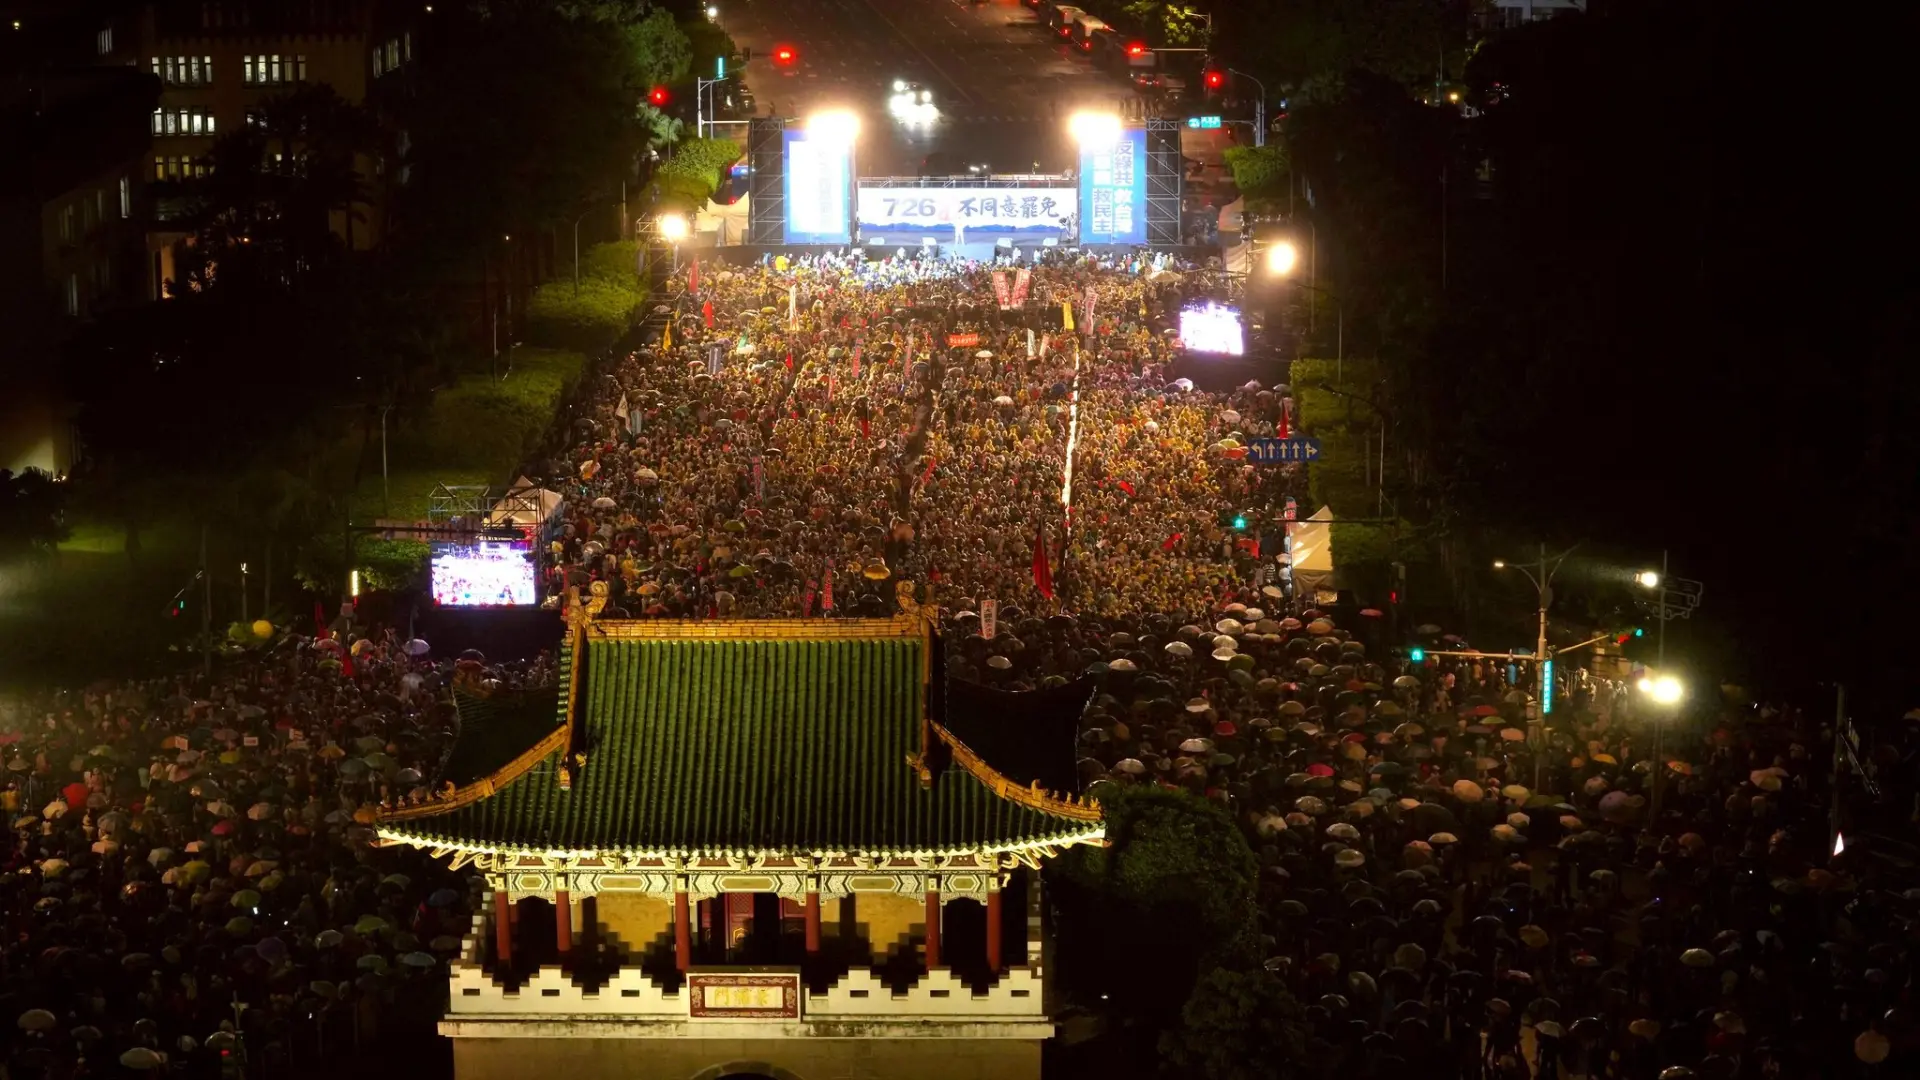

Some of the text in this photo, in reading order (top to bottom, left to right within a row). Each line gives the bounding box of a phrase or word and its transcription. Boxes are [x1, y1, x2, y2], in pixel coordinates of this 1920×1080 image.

[883, 195, 1060, 219] 726 不同意罷免
[1093, 189, 1112, 233] 救民主
